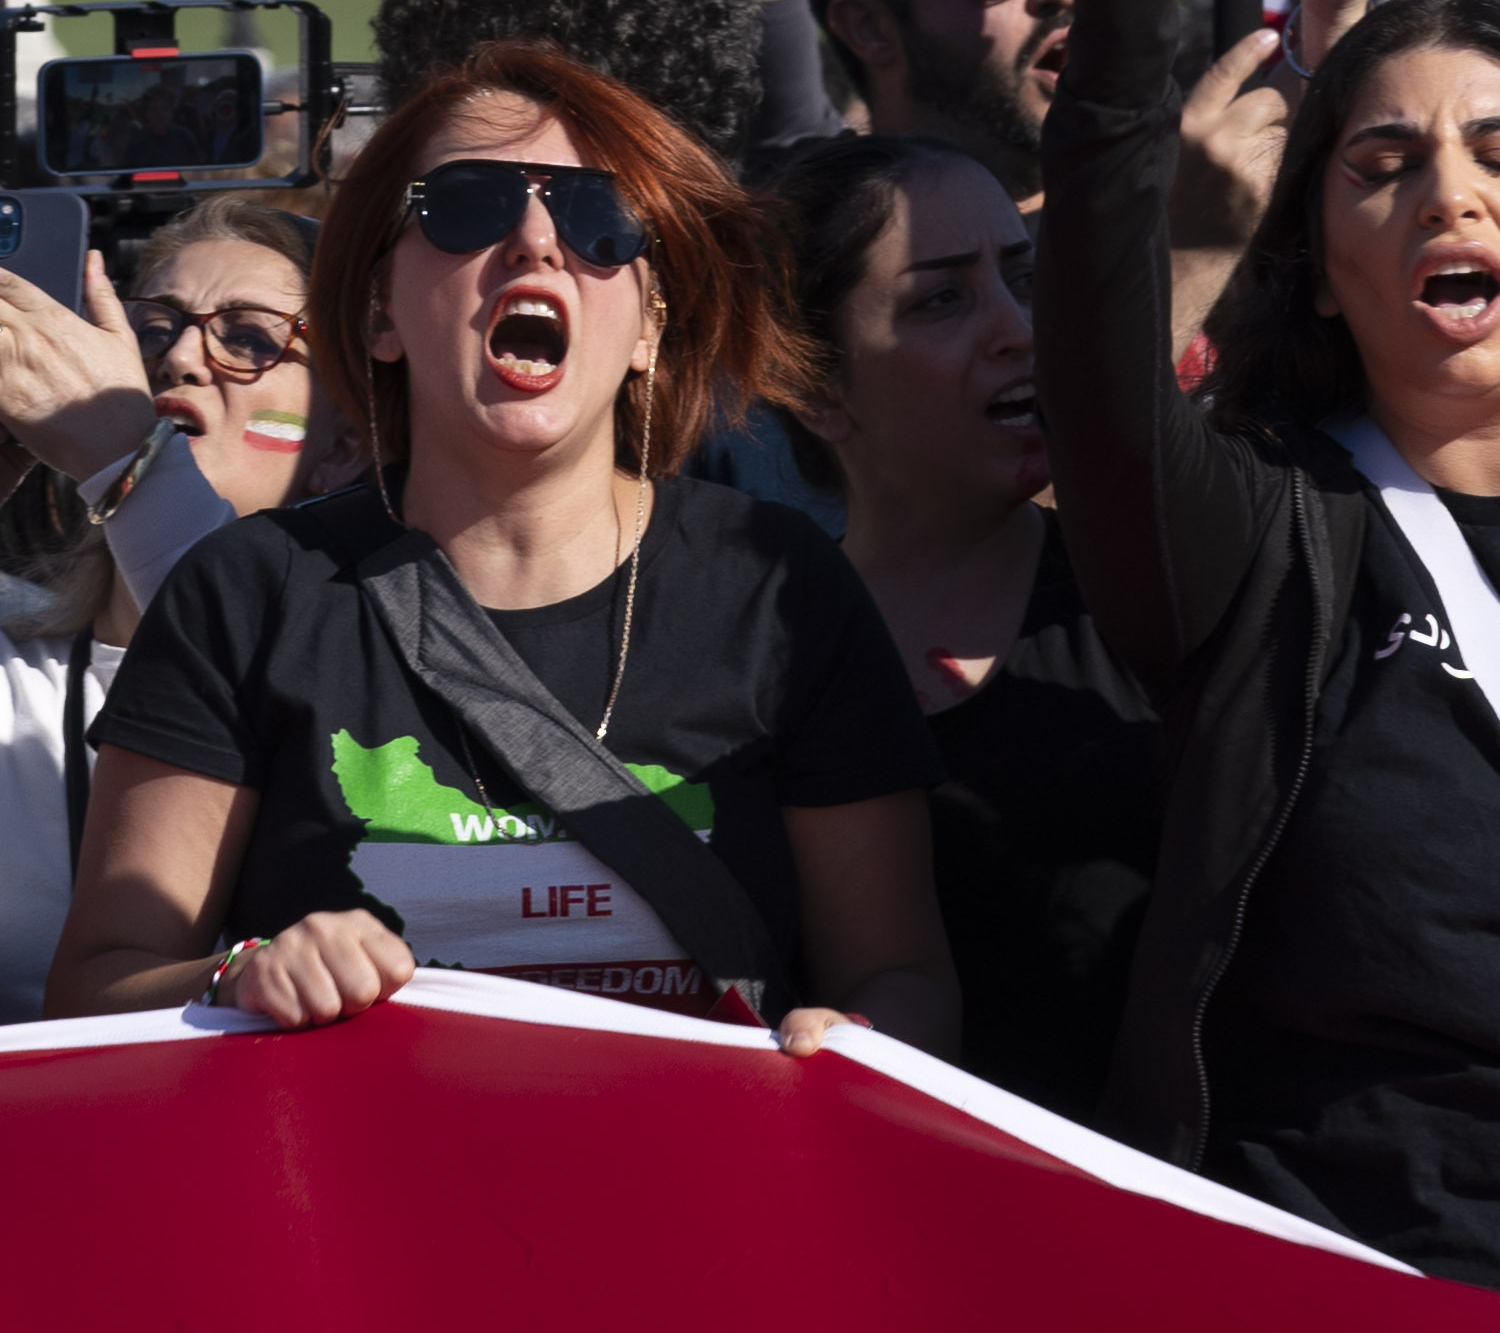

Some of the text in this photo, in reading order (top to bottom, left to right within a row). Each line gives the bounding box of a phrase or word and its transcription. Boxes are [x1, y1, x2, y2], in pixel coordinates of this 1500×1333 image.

[449, 812, 568, 842] WOM
[521, 883, 613, 919] LIFE
[502, 966, 701, 995] REEDOM
